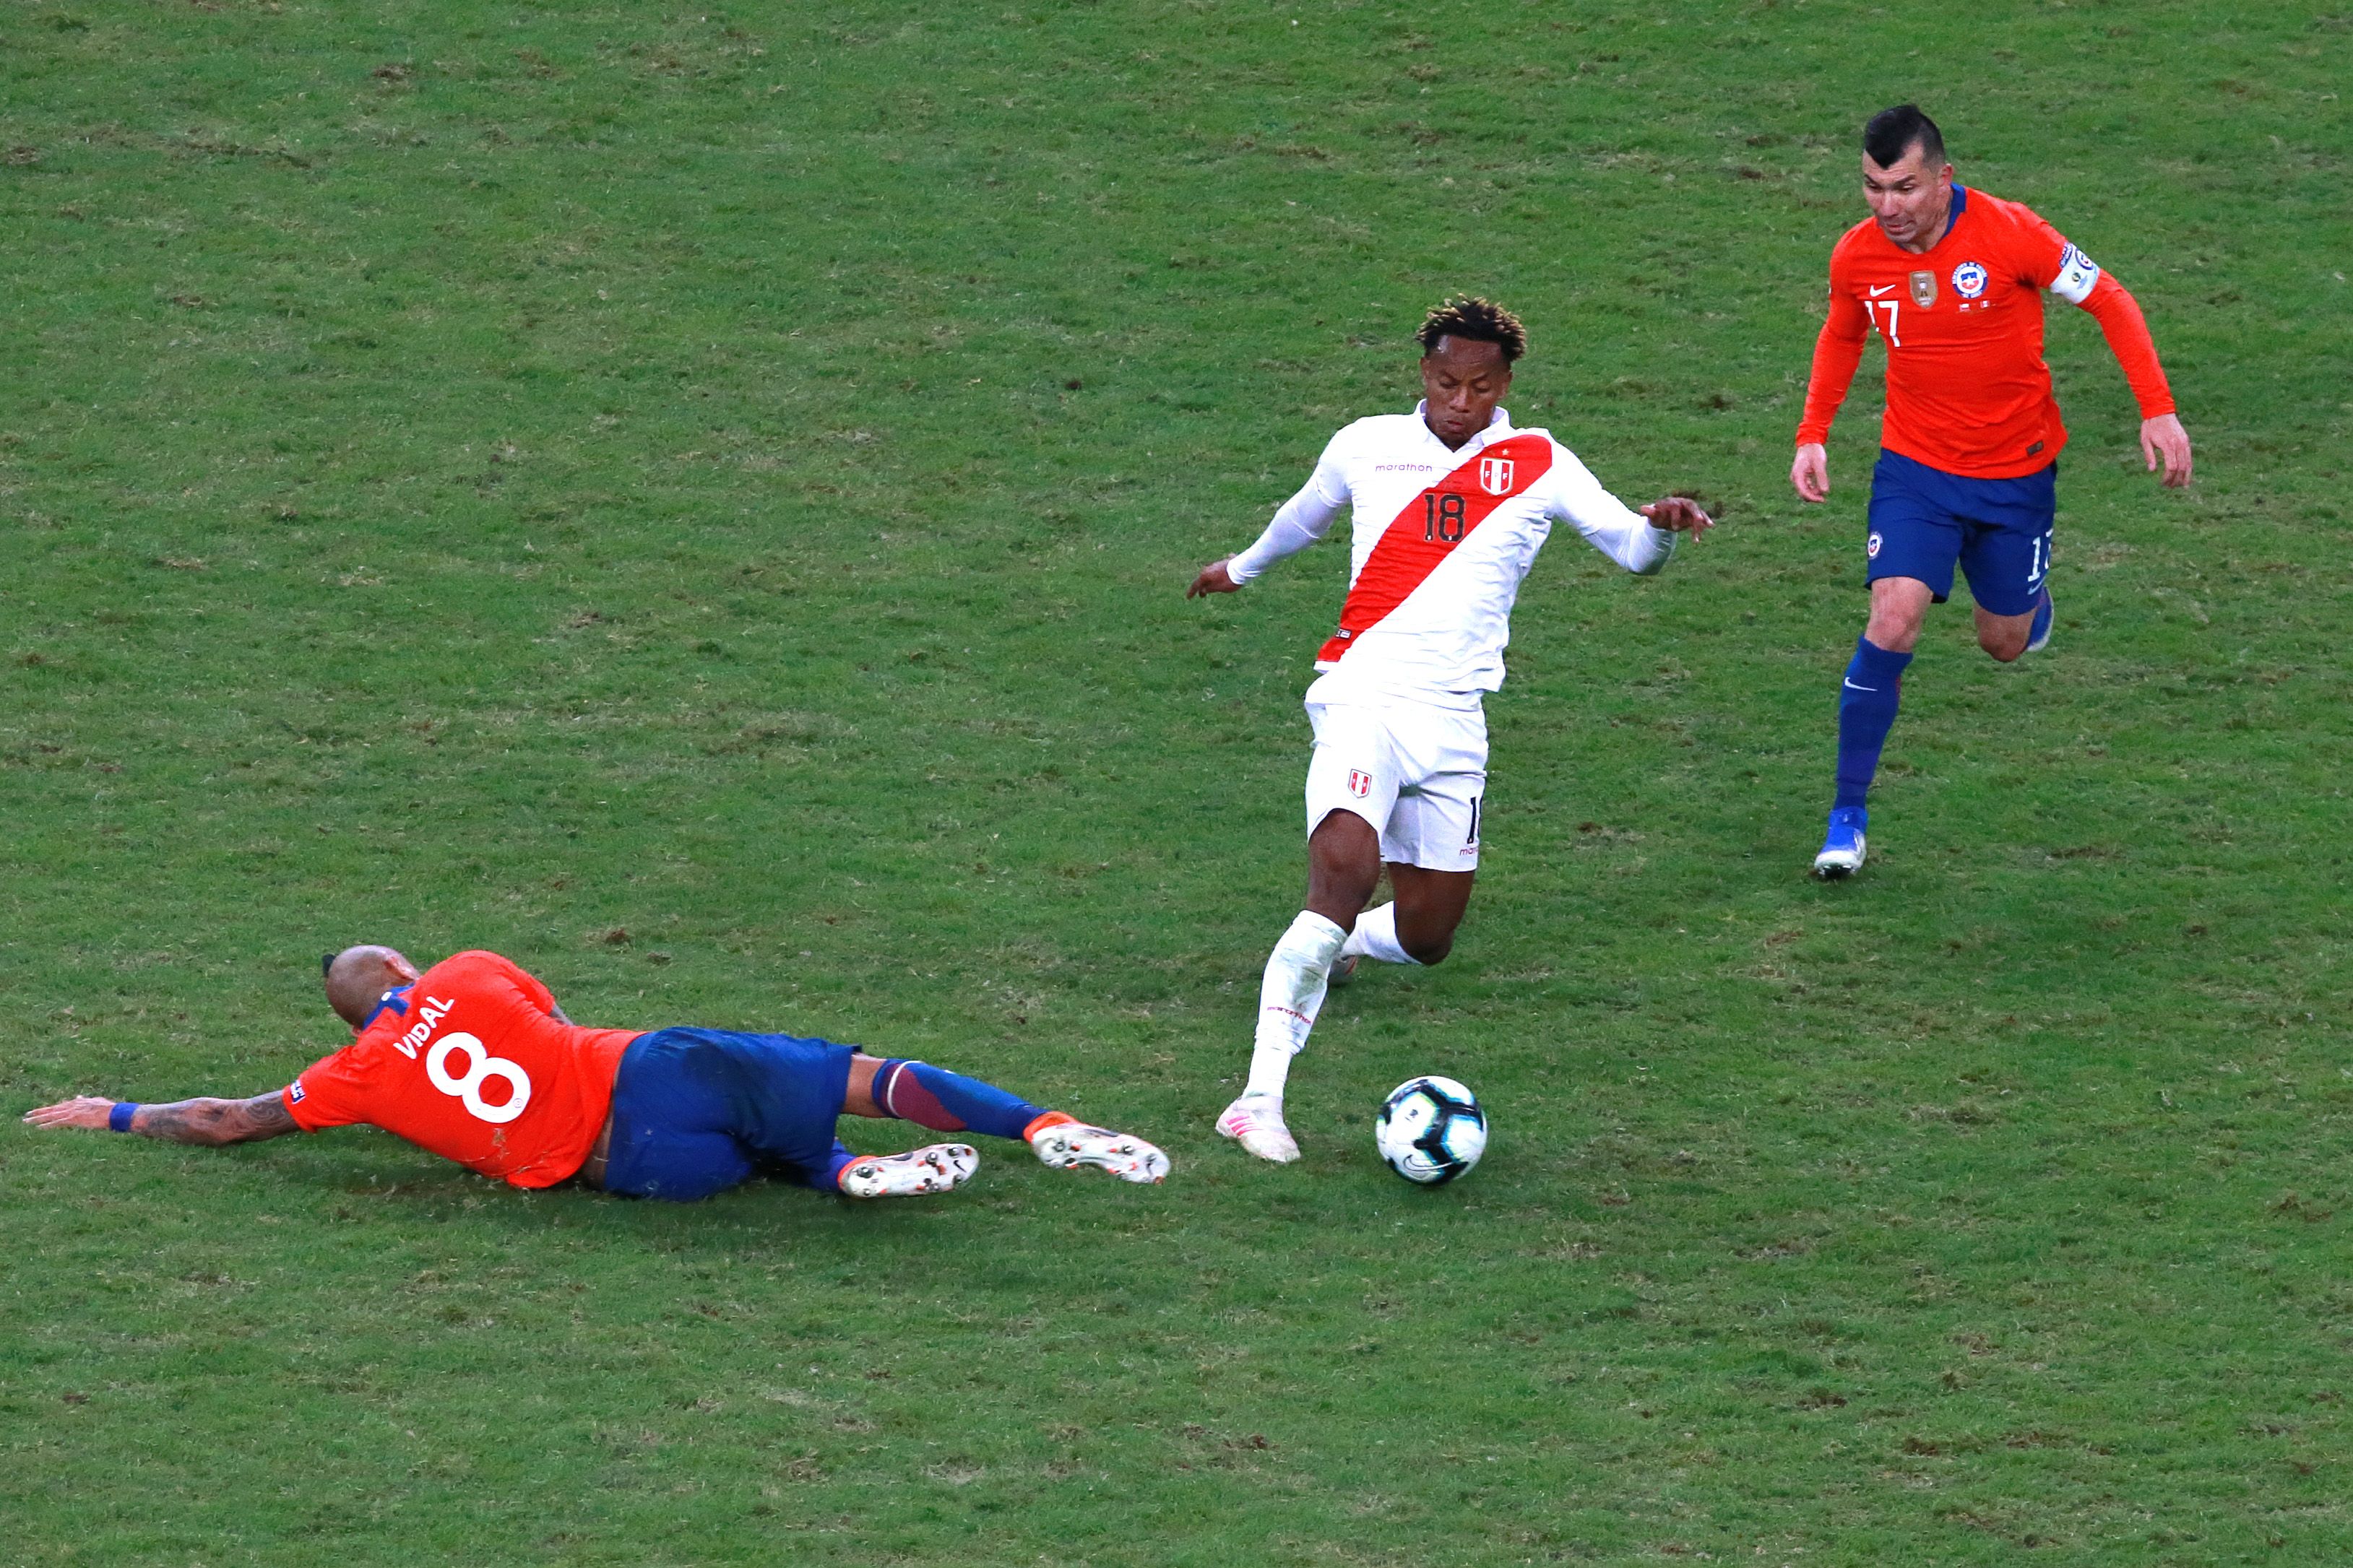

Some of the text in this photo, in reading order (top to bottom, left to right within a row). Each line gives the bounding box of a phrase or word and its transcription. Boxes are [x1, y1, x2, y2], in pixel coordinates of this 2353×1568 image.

[1864, 300, 1901, 347] 17
[1375, 463, 1433, 472] marathon
[1423, 493, 1466, 542] 18
[392, 995, 455, 1060] VIDAL
[426, 1031, 532, 1125] 8
